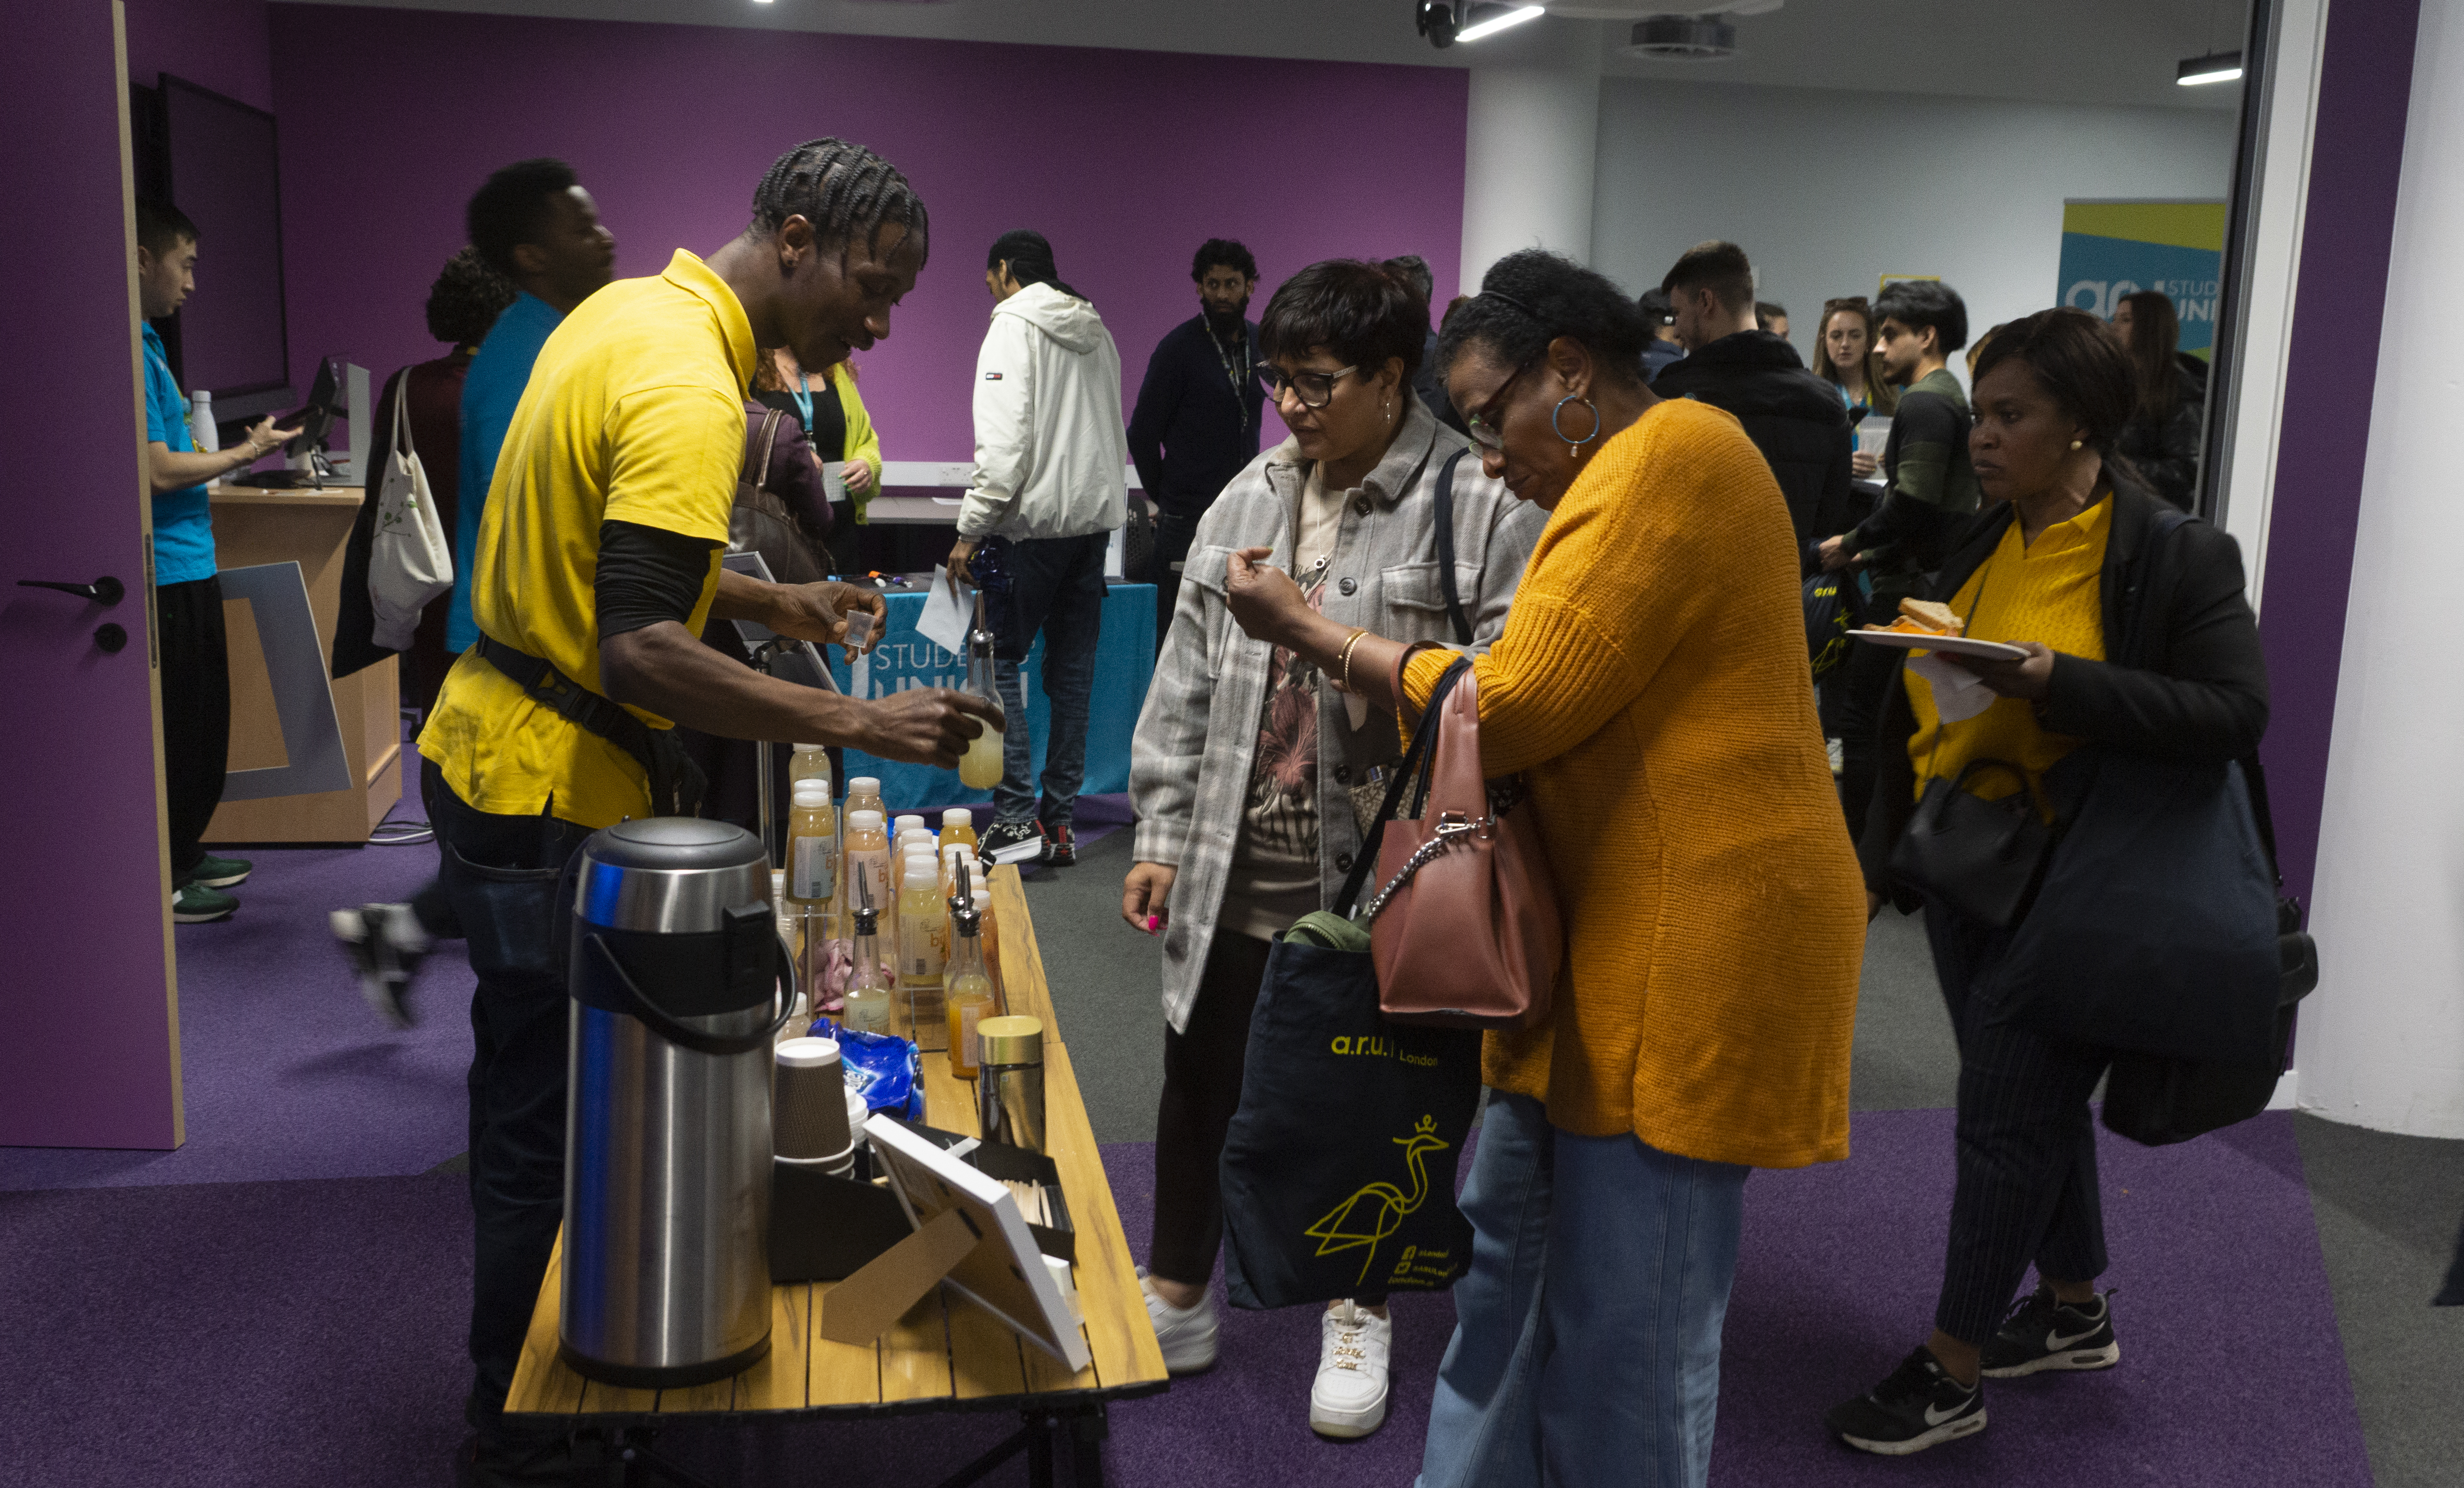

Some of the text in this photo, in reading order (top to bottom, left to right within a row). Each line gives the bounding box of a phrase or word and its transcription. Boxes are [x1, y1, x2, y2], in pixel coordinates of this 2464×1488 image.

[2065, 279, 2165, 322] ar
[1331, 1036, 1438, 1066] a.r.u. London
